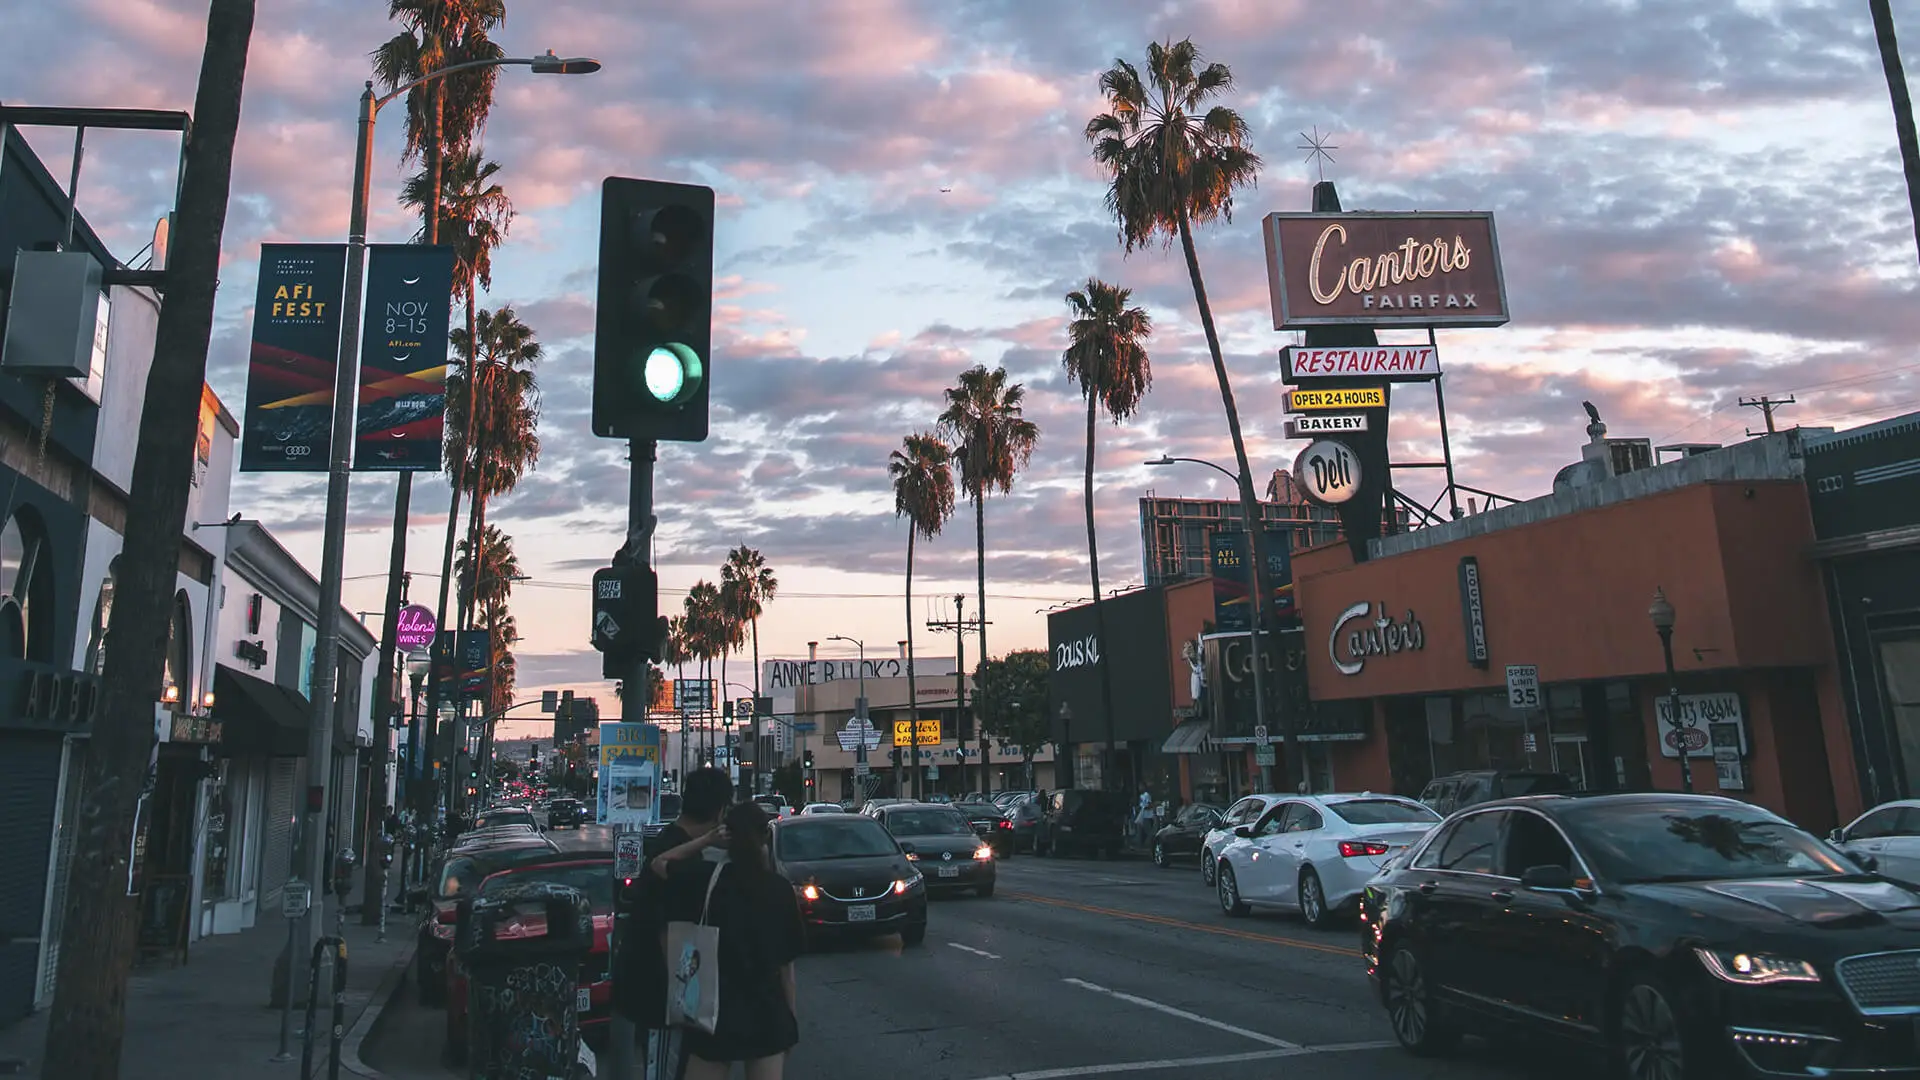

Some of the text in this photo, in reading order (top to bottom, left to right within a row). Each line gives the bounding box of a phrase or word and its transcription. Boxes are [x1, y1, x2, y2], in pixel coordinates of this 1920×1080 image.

[274, 285, 313, 300] AFI
[1363, 293, 1479, 309] FAIRFAX
[272, 302, 326, 317] FEST
[386, 301, 429, 317] NOV
[385, 318, 427, 334] 8-15
[388, 340, 422, 348] AFI.com
[1294, 348, 1433, 374] RESTAURANT
[1294, 391, 1381, 406] OPEN 24 HOURS
[1300, 416, 1363, 430] BAKERY
[1309, 447, 1352, 494] Deli
[1217, 549, 1234, 557] AFI
[1217, 557, 1240, 565] FEST
[1467, 568, 1485, 657] COCKTAILS
[399, 635, 427, 643] WINES
[1329, 601, 1424, 675] Canter's
[824, 661, 835, 682] R
[1508, 668, 1535, 677] SPEED
[1512, 678, 1533, 686] LIMIT
[1513, 688, 1537, 704] 35
[902, 735, 934, 744] PAKING
